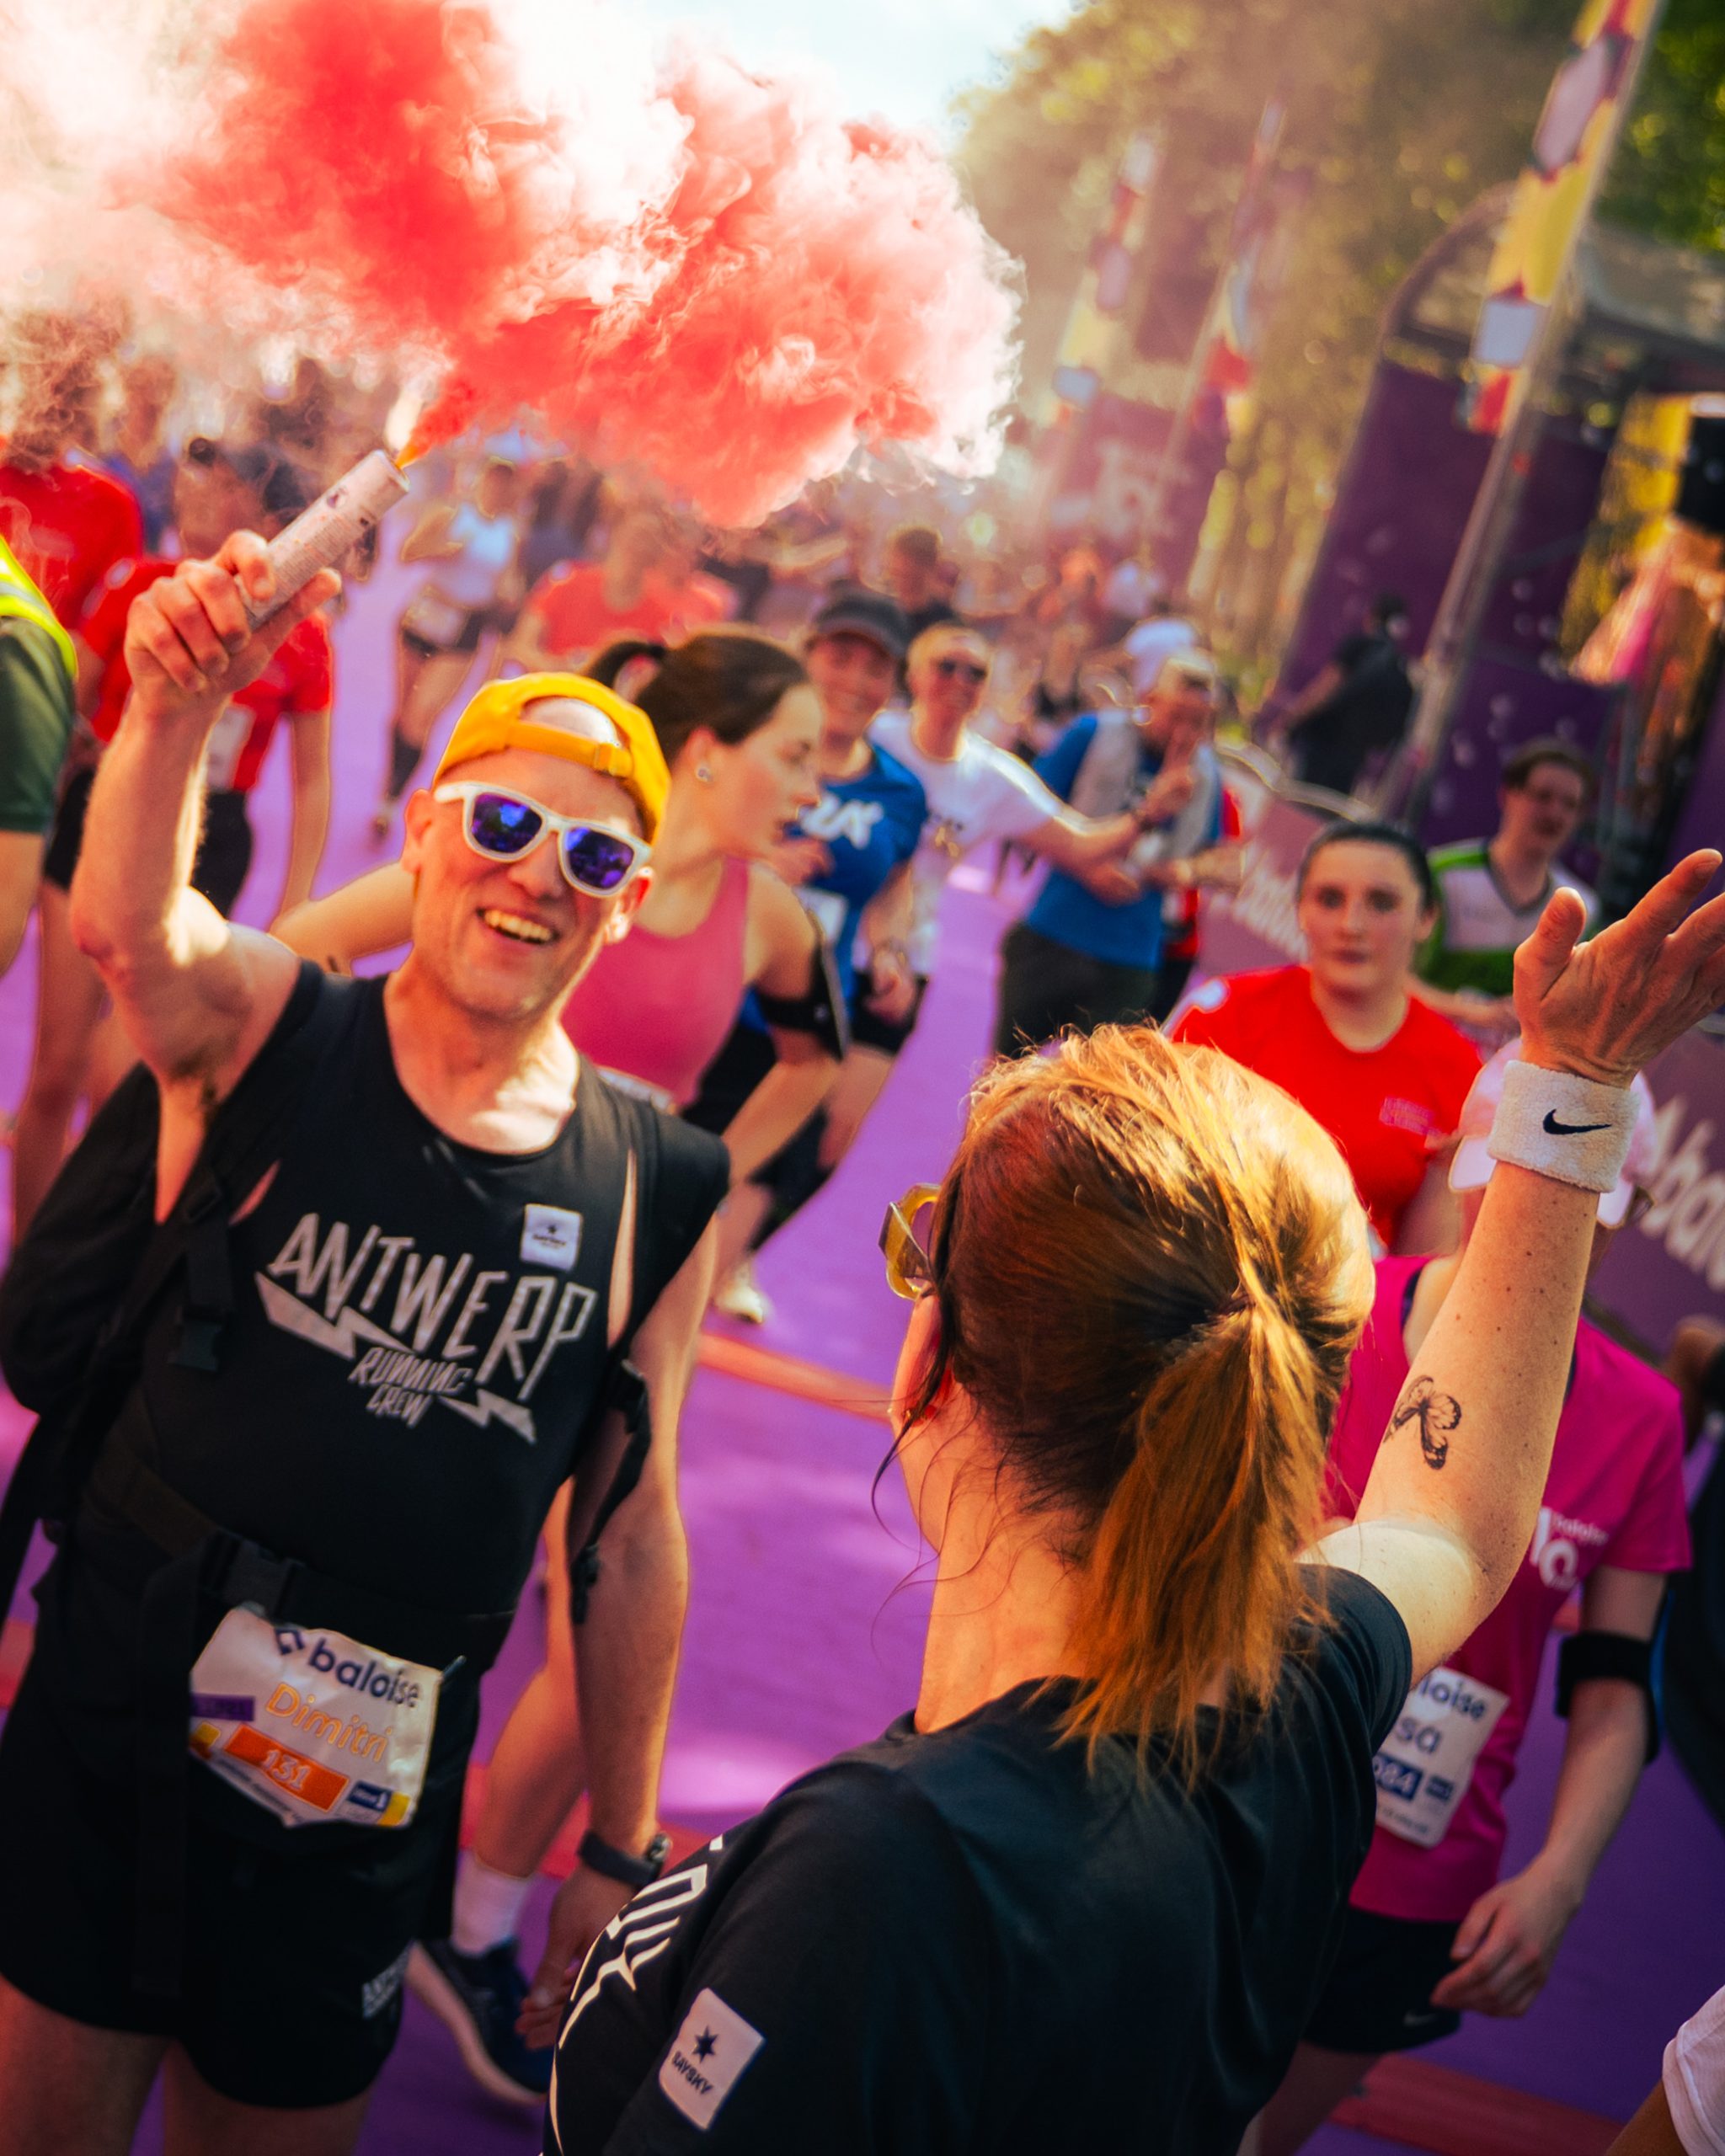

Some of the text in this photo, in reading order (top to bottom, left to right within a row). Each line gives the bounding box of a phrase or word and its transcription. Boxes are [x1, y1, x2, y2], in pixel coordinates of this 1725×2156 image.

[267, 1213, 597, 1401] ANTWERP
[348, 1347, 473, 1396] RUNNING
[366, 1385, 435, 1429] CREW
[308, 1638, 420, 1708] baloise
[1419, 1677, 1487, 1721] loise
[265, 1682, 393, 1763] Dimitri
[1396, 1716, 1441, 1753] sa
[261, 1748, 310, 1791] 131
[671, 2050, 714, 2095] SAYSKY
